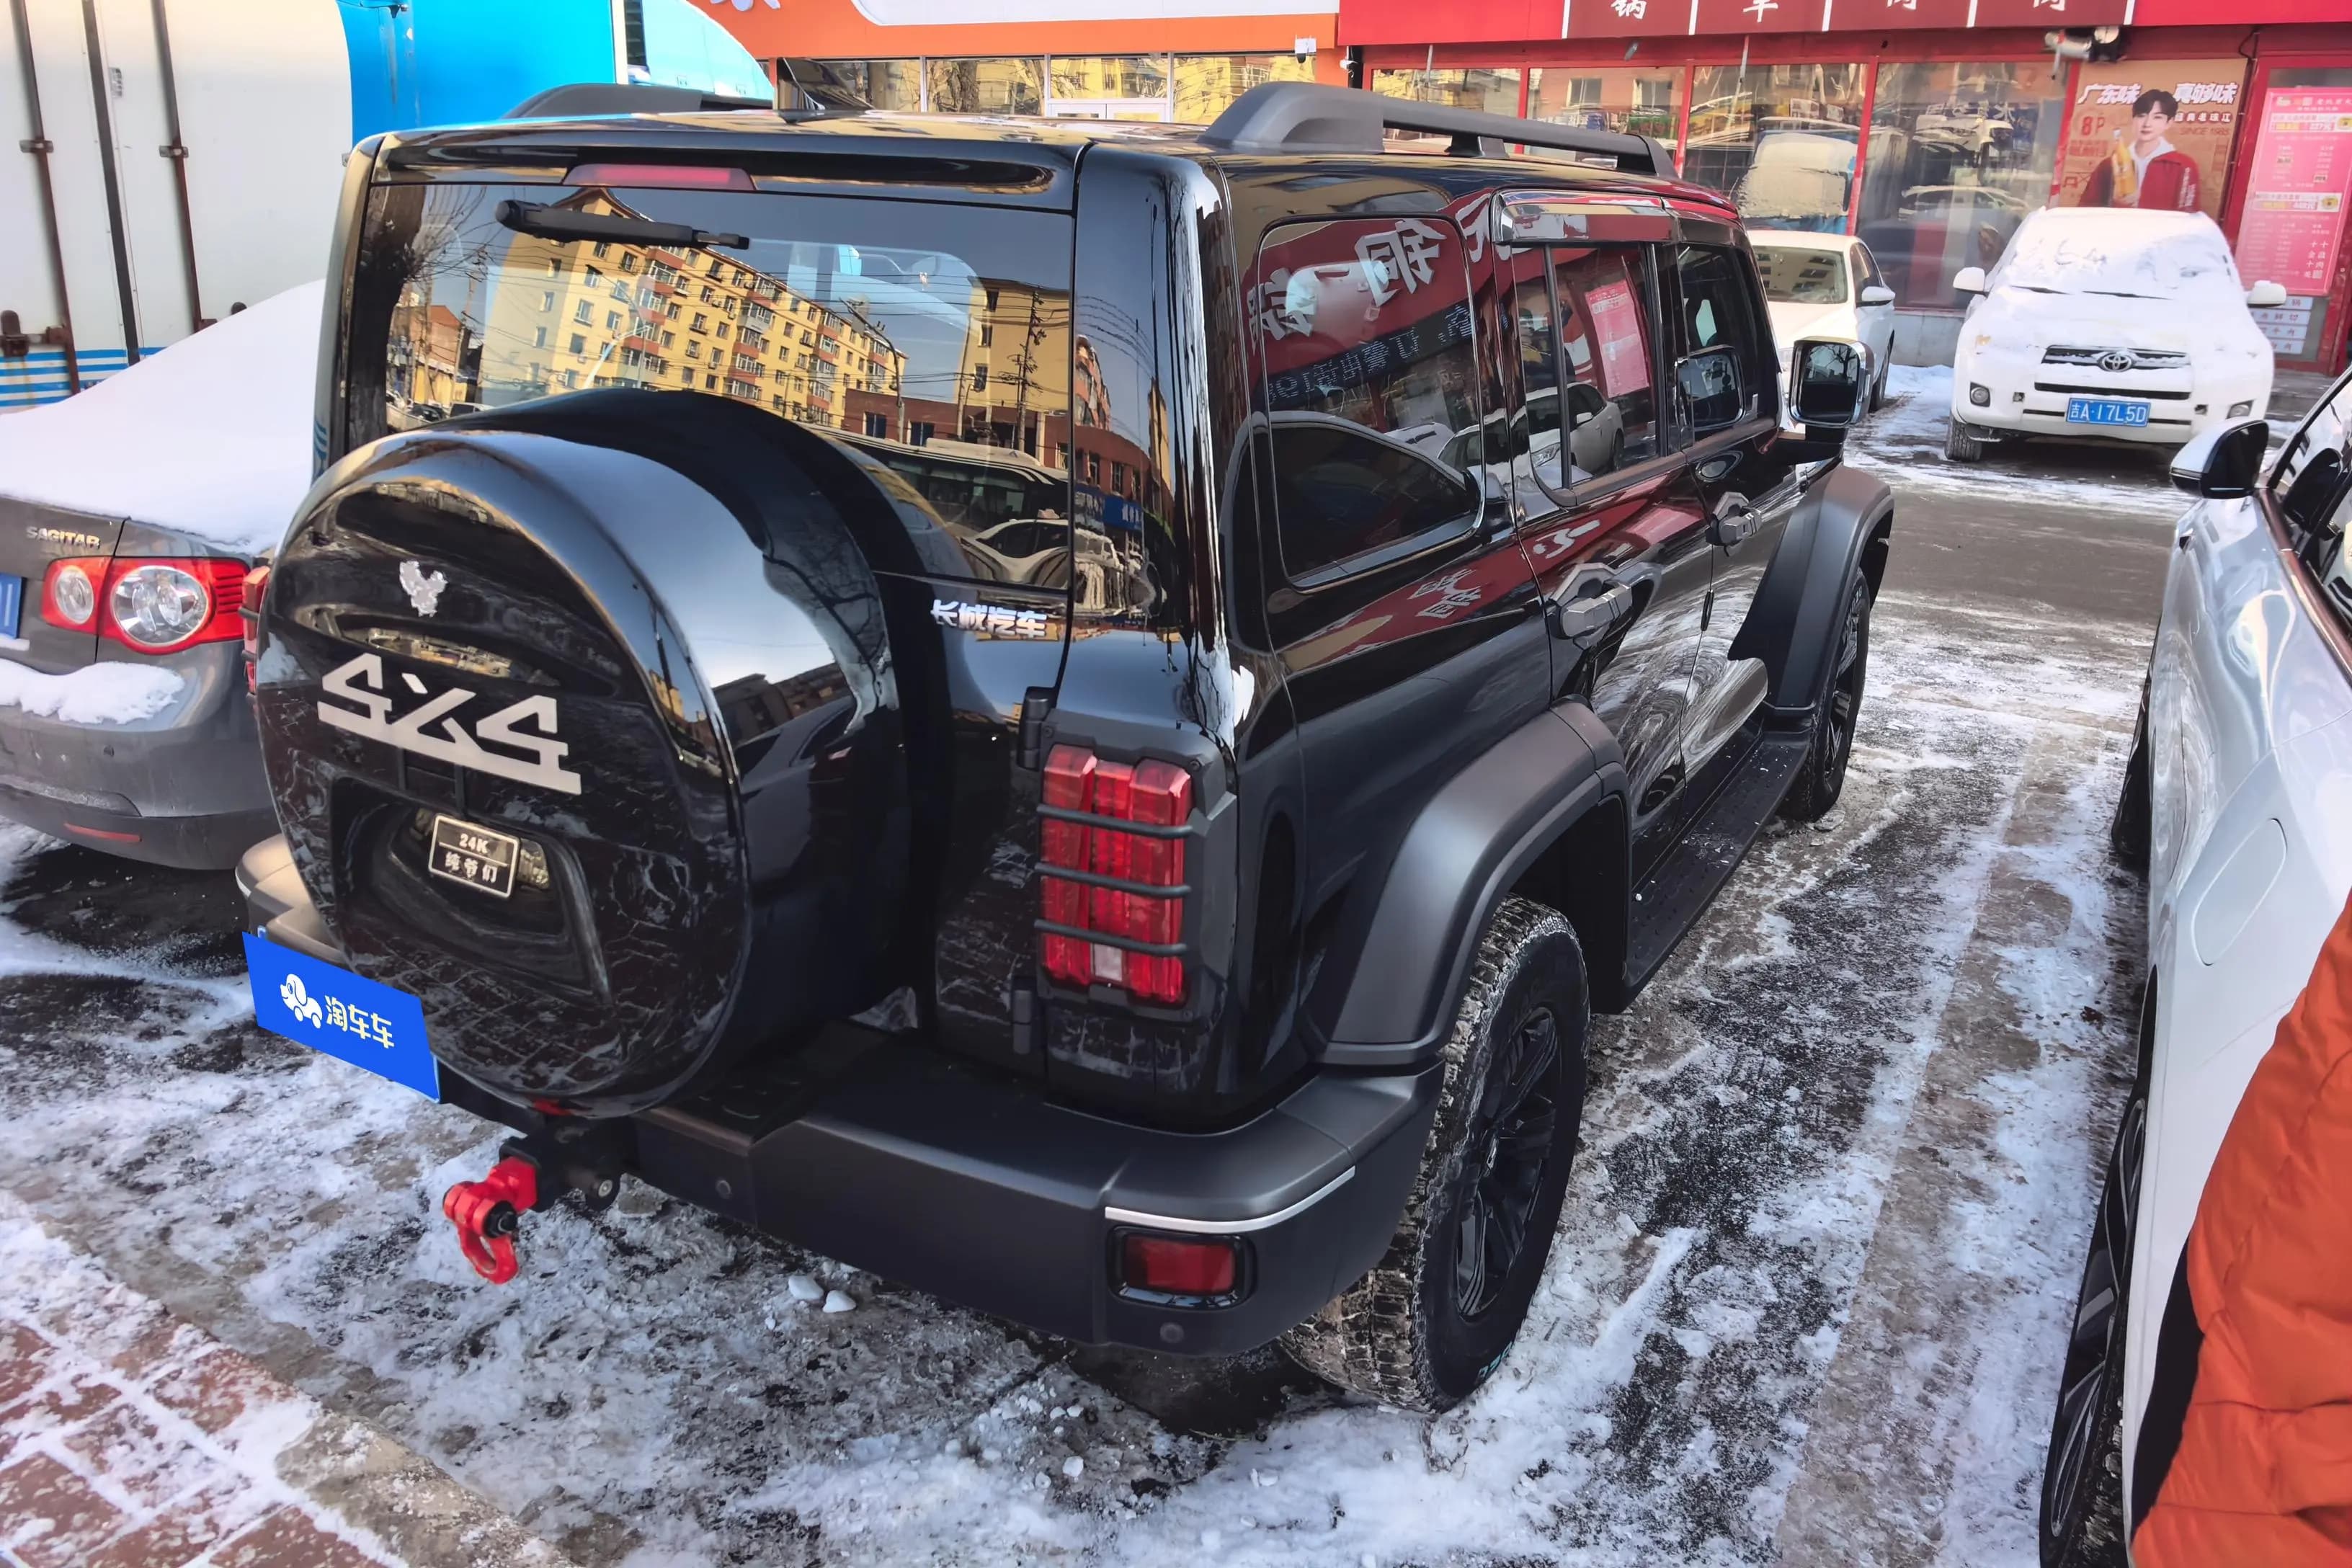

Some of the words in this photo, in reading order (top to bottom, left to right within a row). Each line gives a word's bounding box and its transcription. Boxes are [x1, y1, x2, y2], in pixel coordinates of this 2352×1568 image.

[2077, 83, 2142, 104] 广东味
[2172, 82, 2239, 104] 真够味
[26, 526, 100, 549] SAGITAR
[930, 600, 1047, 639] 长城汽车
[459, 834, 489, 854] 24K
